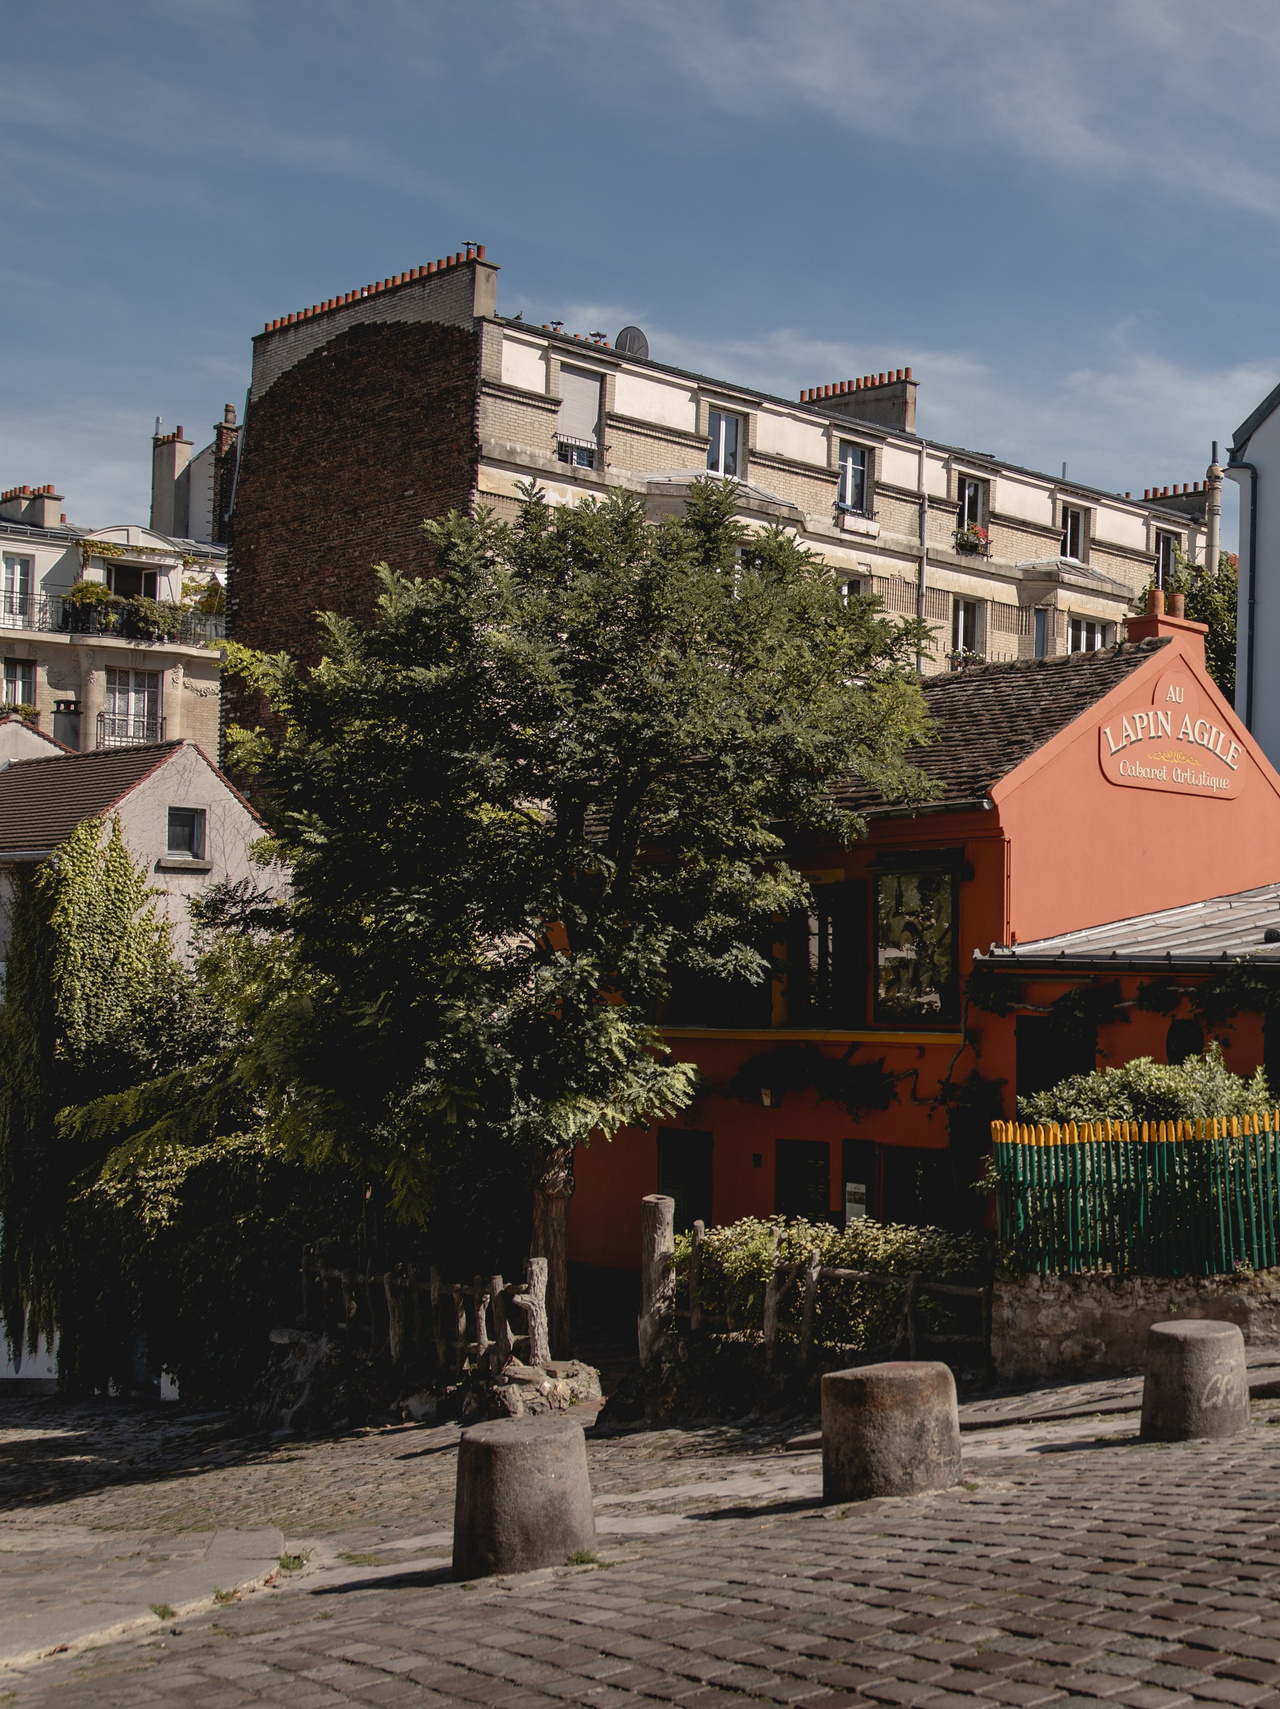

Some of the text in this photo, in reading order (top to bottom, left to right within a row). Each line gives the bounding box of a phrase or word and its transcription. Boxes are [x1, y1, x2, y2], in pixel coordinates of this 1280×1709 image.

[1165, 684, 1184, 703] AU
[1103, 710, 1242, 771] LAPIN AGILE
[1119, 760, 1168, 781] Cabaret
